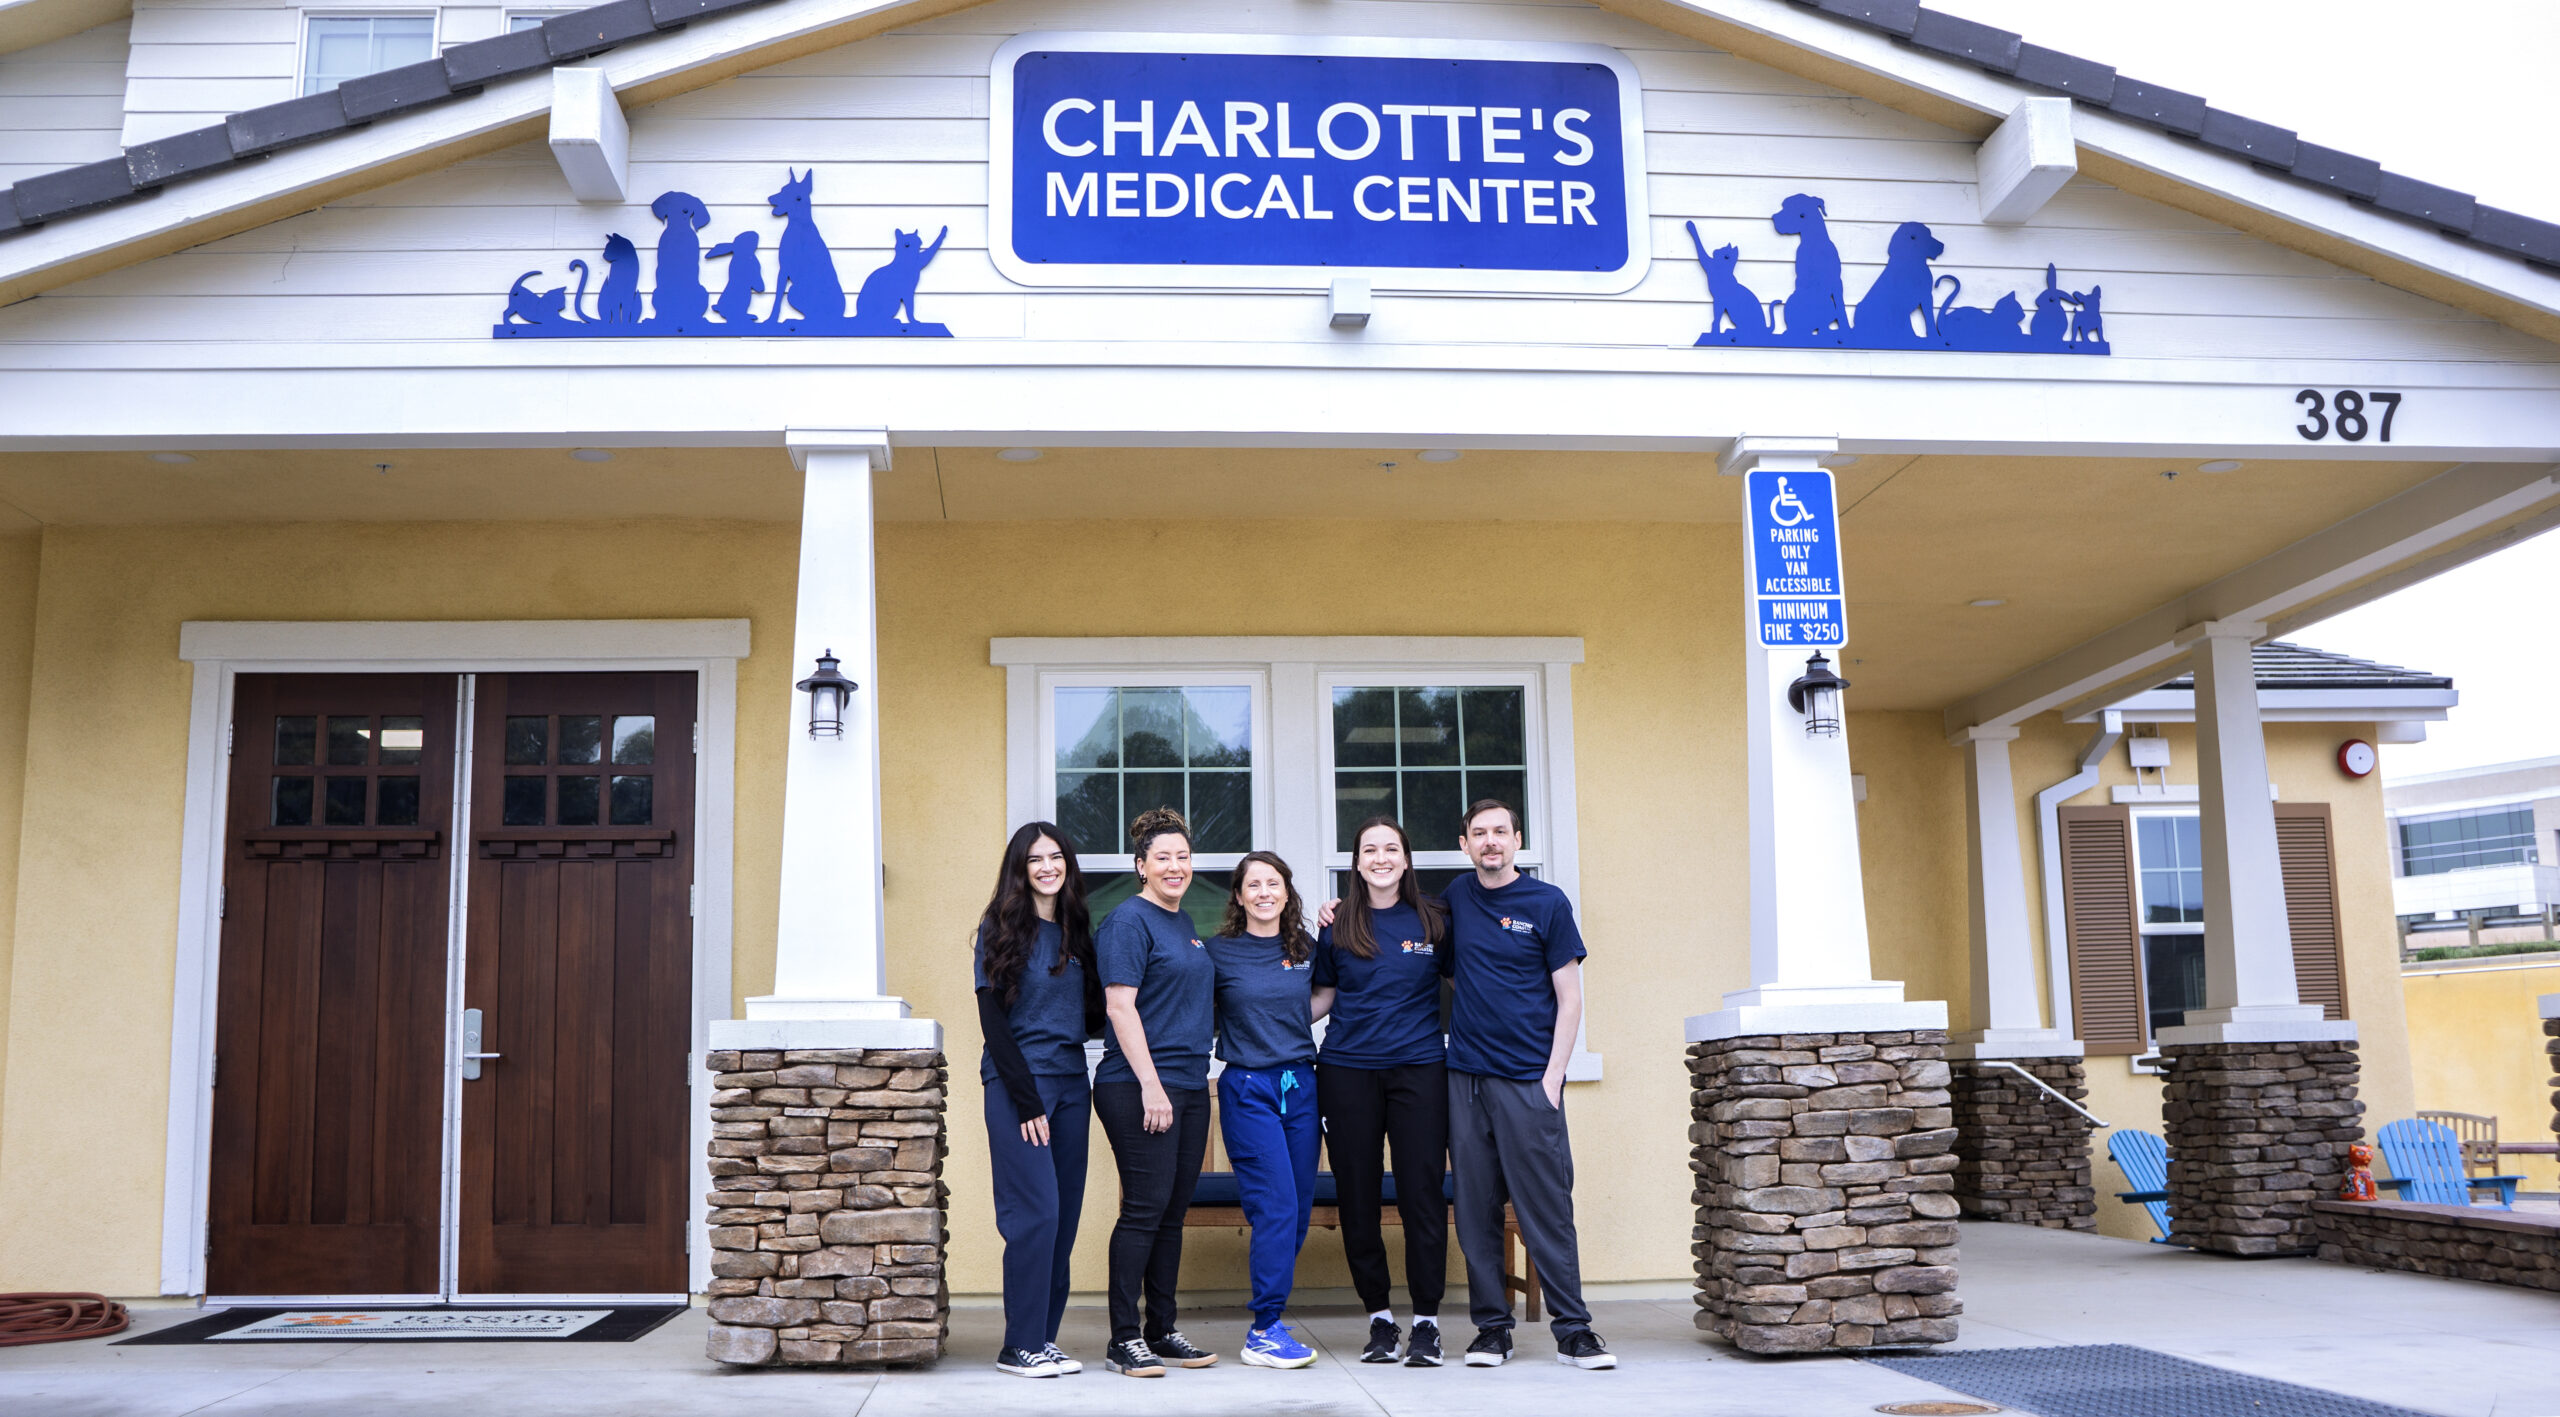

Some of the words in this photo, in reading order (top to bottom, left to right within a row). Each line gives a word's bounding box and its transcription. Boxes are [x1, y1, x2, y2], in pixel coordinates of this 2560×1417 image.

[1042, 97, 1594, 167] CHARLOTTE'S
[1046, 171, 1334, 220] MEDICAL
[1353, 175, 1598, 226] CENTER
[2295, 389, 2402, 443] 387
[1770, 528, 1819, 543] PARKING
[1781, 545, 1811, 559] ONLY
[1785, 561, 1808, 576] VAN
[1765, 578, 1832, 593] ACCESSIBLE
[1772, 602, 1829, 620] MINIMUM
[1764, 623, 1793, 641] FINE
[1802, 622, 1840, 642] $250
